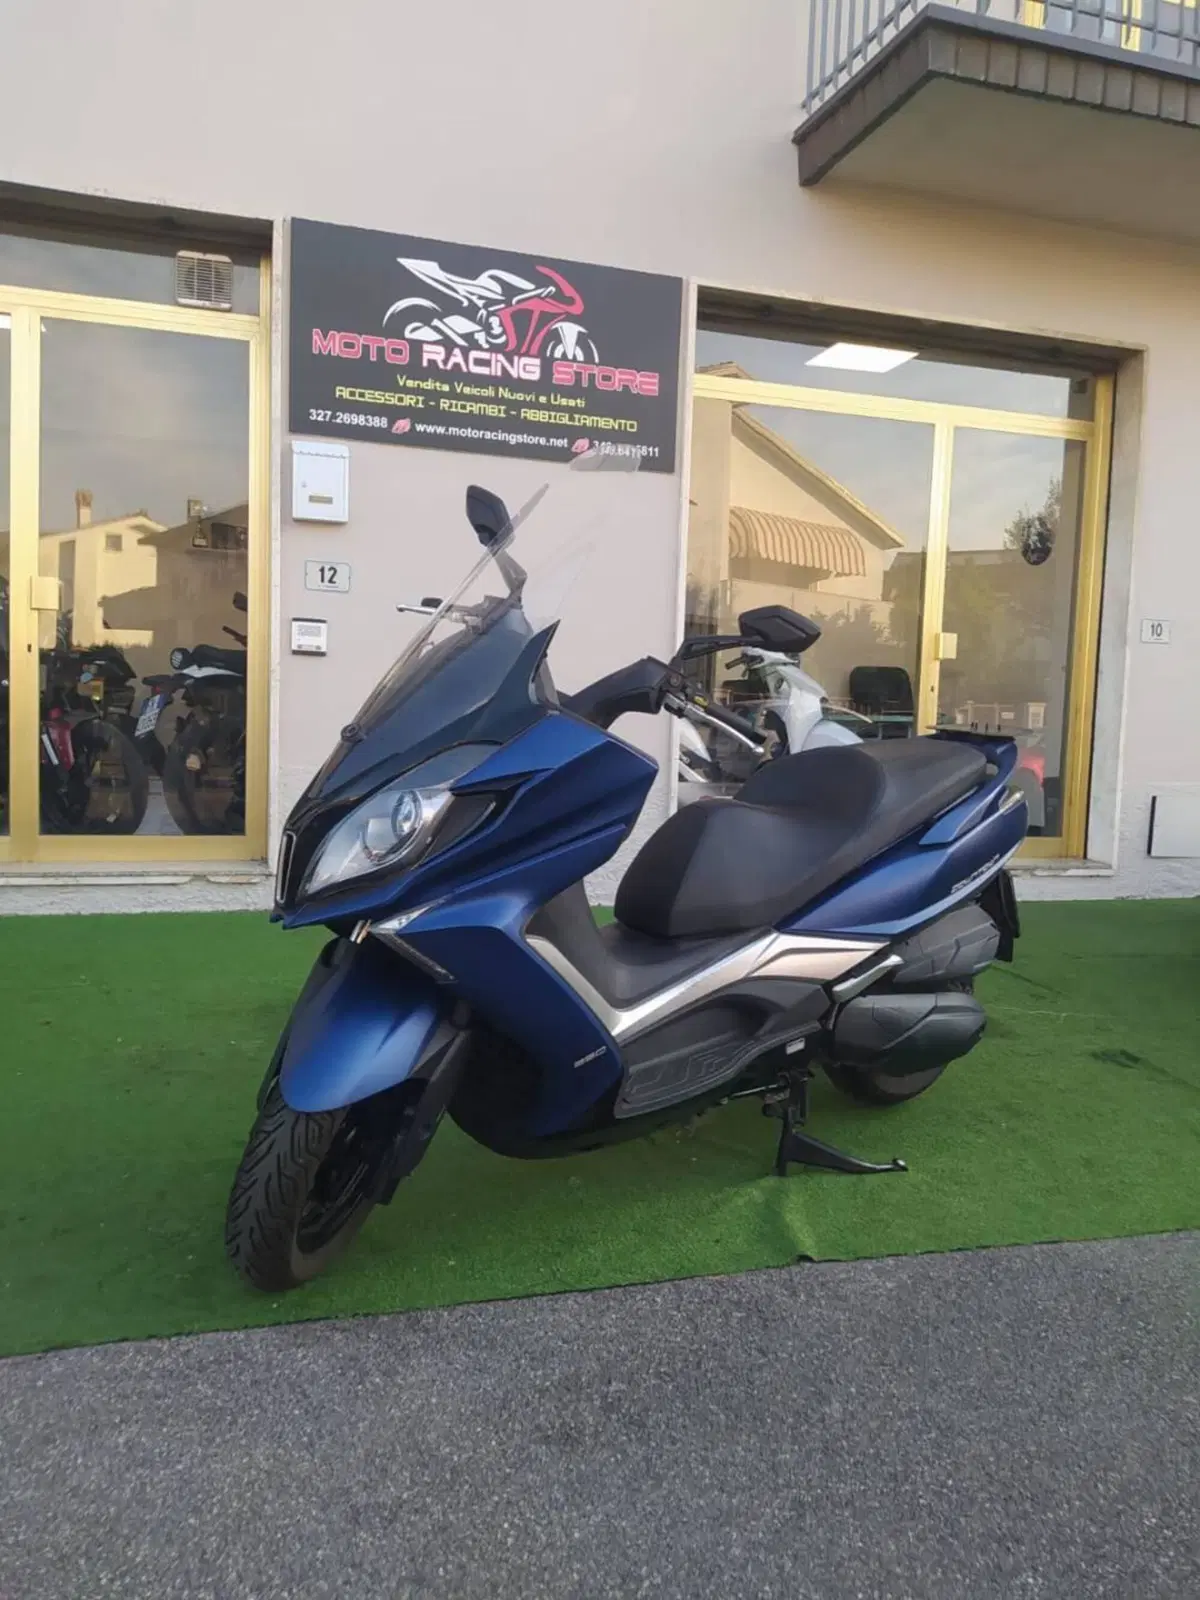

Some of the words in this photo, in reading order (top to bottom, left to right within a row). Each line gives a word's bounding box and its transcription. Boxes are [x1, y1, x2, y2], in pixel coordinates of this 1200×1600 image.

[311, 328, 410, 365] MOTO
[422, 343, 541, 381] RACING
[552, 361, 659, 396] STORE
[335, 386, 425, 408] ACCESSORI
[440, 398, 506, 418] RICAMBI
[520, 408, 638, 432] ABBIGLIAMENTO
[396, 374, 450, 392] Vendita
[454, 381, 495, 398] Veicoli
[498, 387, 536, 402] Nuovi
[538, 395, 548, 404] e
[550, 393, 586, 408] Usati
[308, 408, 388, 428] 327.2698388
[414, 422, 568, 448] www.motoracingstore.net
[319, 565, 337, 584] 12
[1150, 623, 1163, 637] 10
